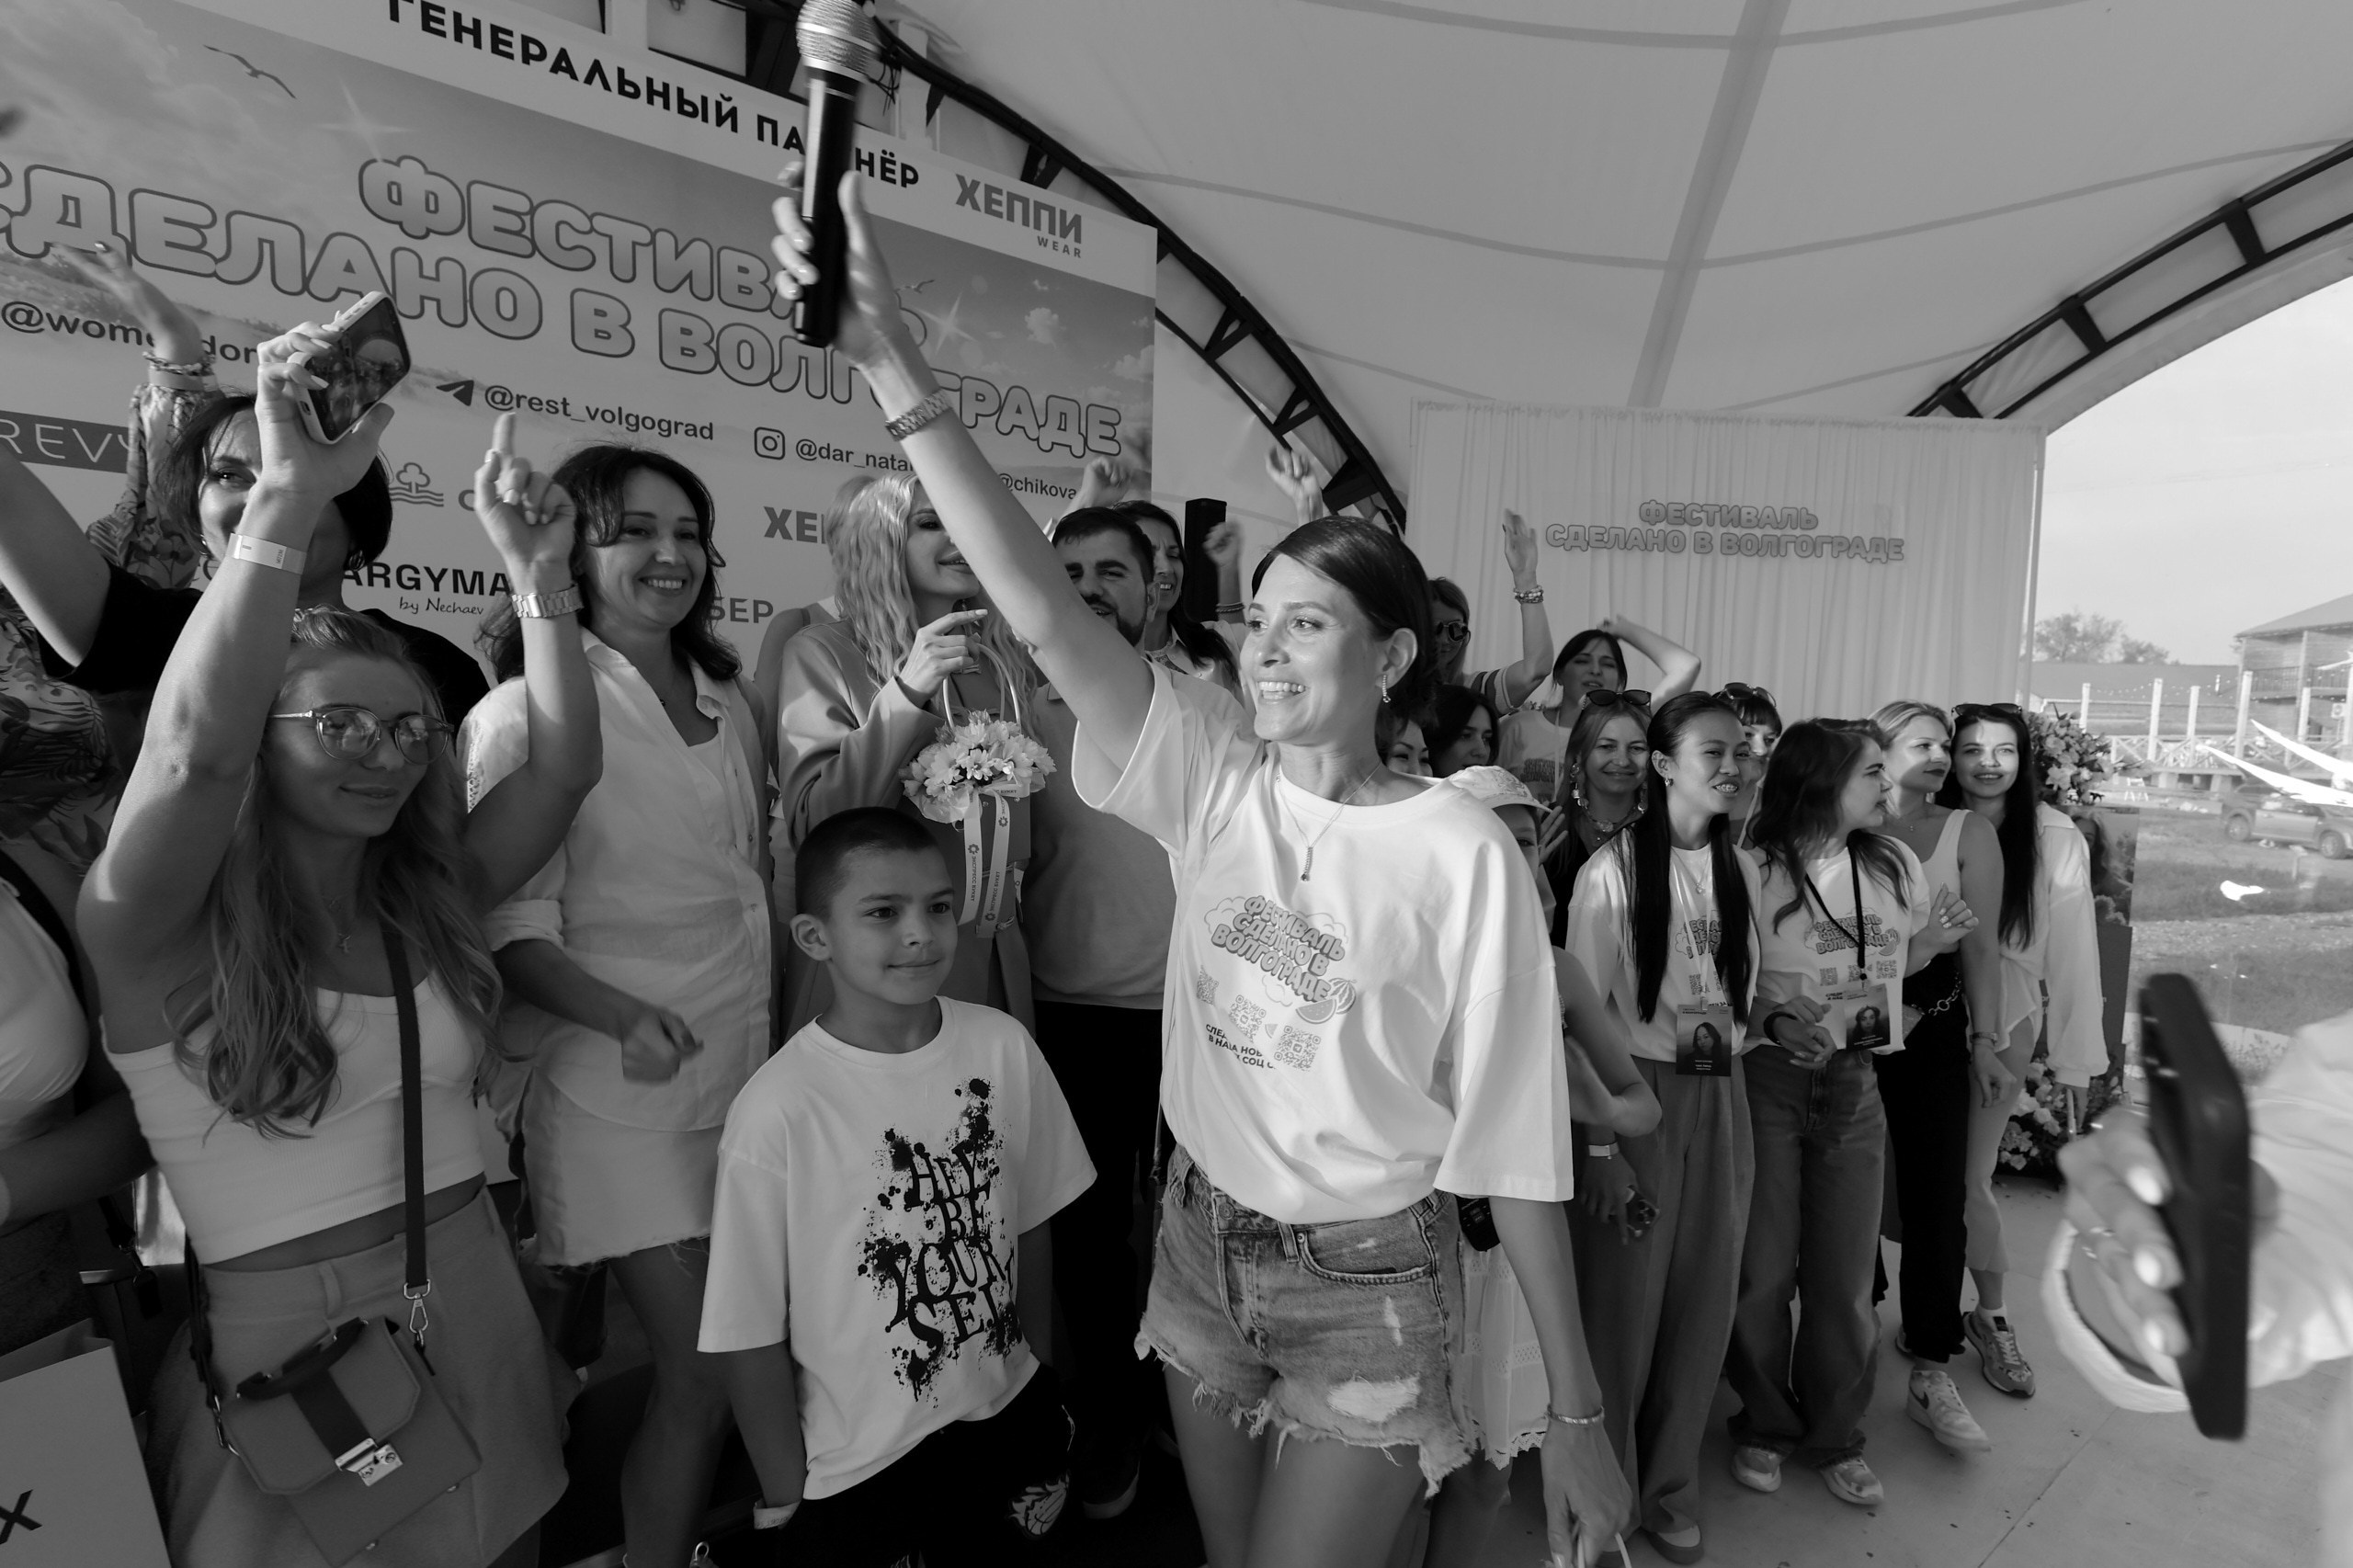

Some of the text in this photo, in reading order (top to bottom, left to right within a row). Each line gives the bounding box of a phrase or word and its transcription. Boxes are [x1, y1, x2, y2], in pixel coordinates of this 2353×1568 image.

[389, 0, 919, 188] ГЕНЕРАЛЬНЫЙ ПАНЁР
[955, 173, 1083, 244] ХЕППИ
[1037, 235, 1083, 259] WEAR
[0, 161, 1122, 459] ДЕЛАНО В ВОЛГРАДЕ
[484, 385, 714, 442] @rest_volgograd
[795, 438, 914, 472] @dar_nata
[1546, 523, 1904, 563] СДЕЛАНО В ВОЛГОГРАДЕ
[1639, 499, 1818, 530] ФЕСТИВАЛЬ
[400, 597, 484, 615] by Nechaev
[1233, 913, 1329, 976] СДЕЛАНО В
[1245, 895, 1346, 961] ФЕСТИВАЛЬ
[1211, 924, 1332, 1003] ВОЛГОГРАДЕ
[1243, 1056, 1265, 1068] СОЦ
[904, 1140, 989, 1211] HEY
[939, 1182, 992, 1243] BE
[878, 1235, 1007, 1332] YOUR
